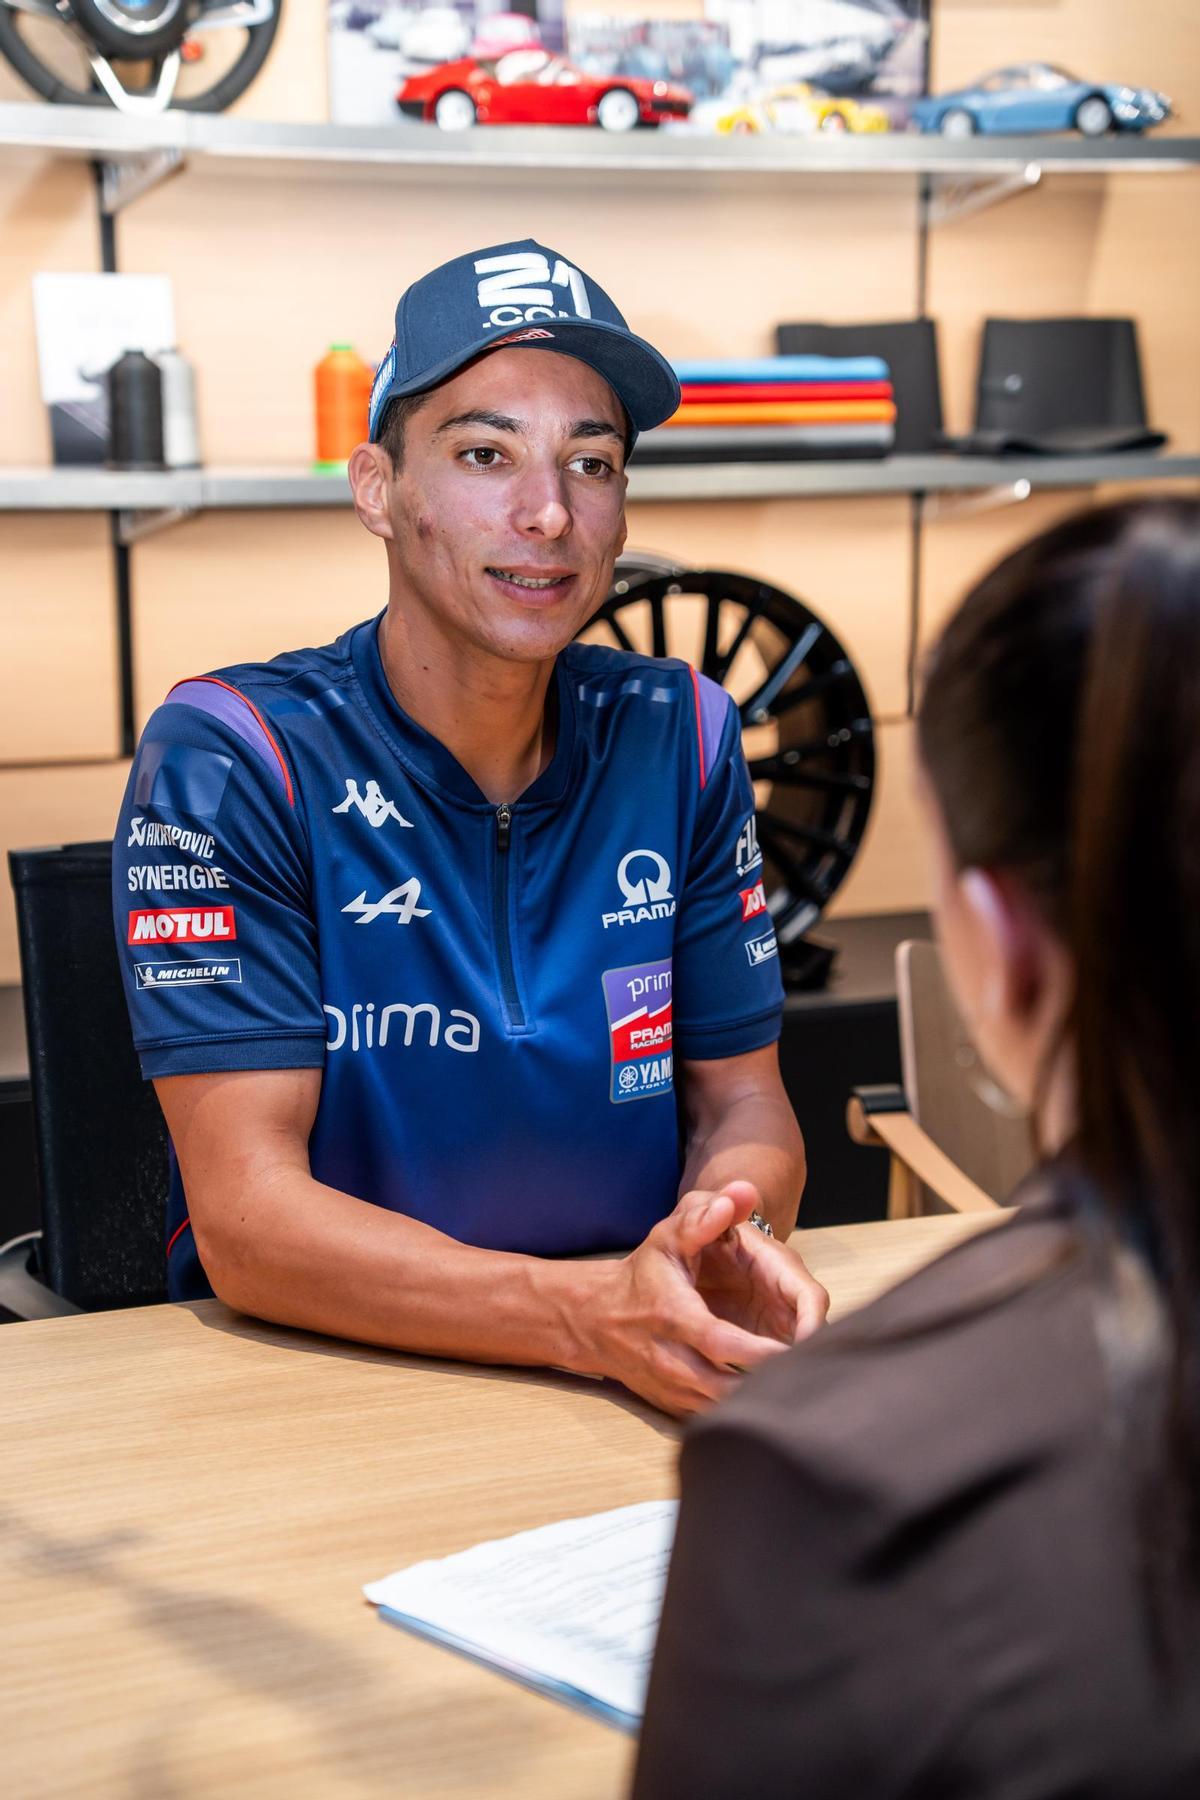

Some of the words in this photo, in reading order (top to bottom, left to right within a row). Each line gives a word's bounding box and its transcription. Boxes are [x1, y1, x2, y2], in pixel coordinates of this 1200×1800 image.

[127, 864, 230, 892] SYNERGIE
[132, 911, 230, 940] MOTUL
[156, 966, 230, 980] MICHELIN
[618, 1080, 666, 1095] FACTORY
